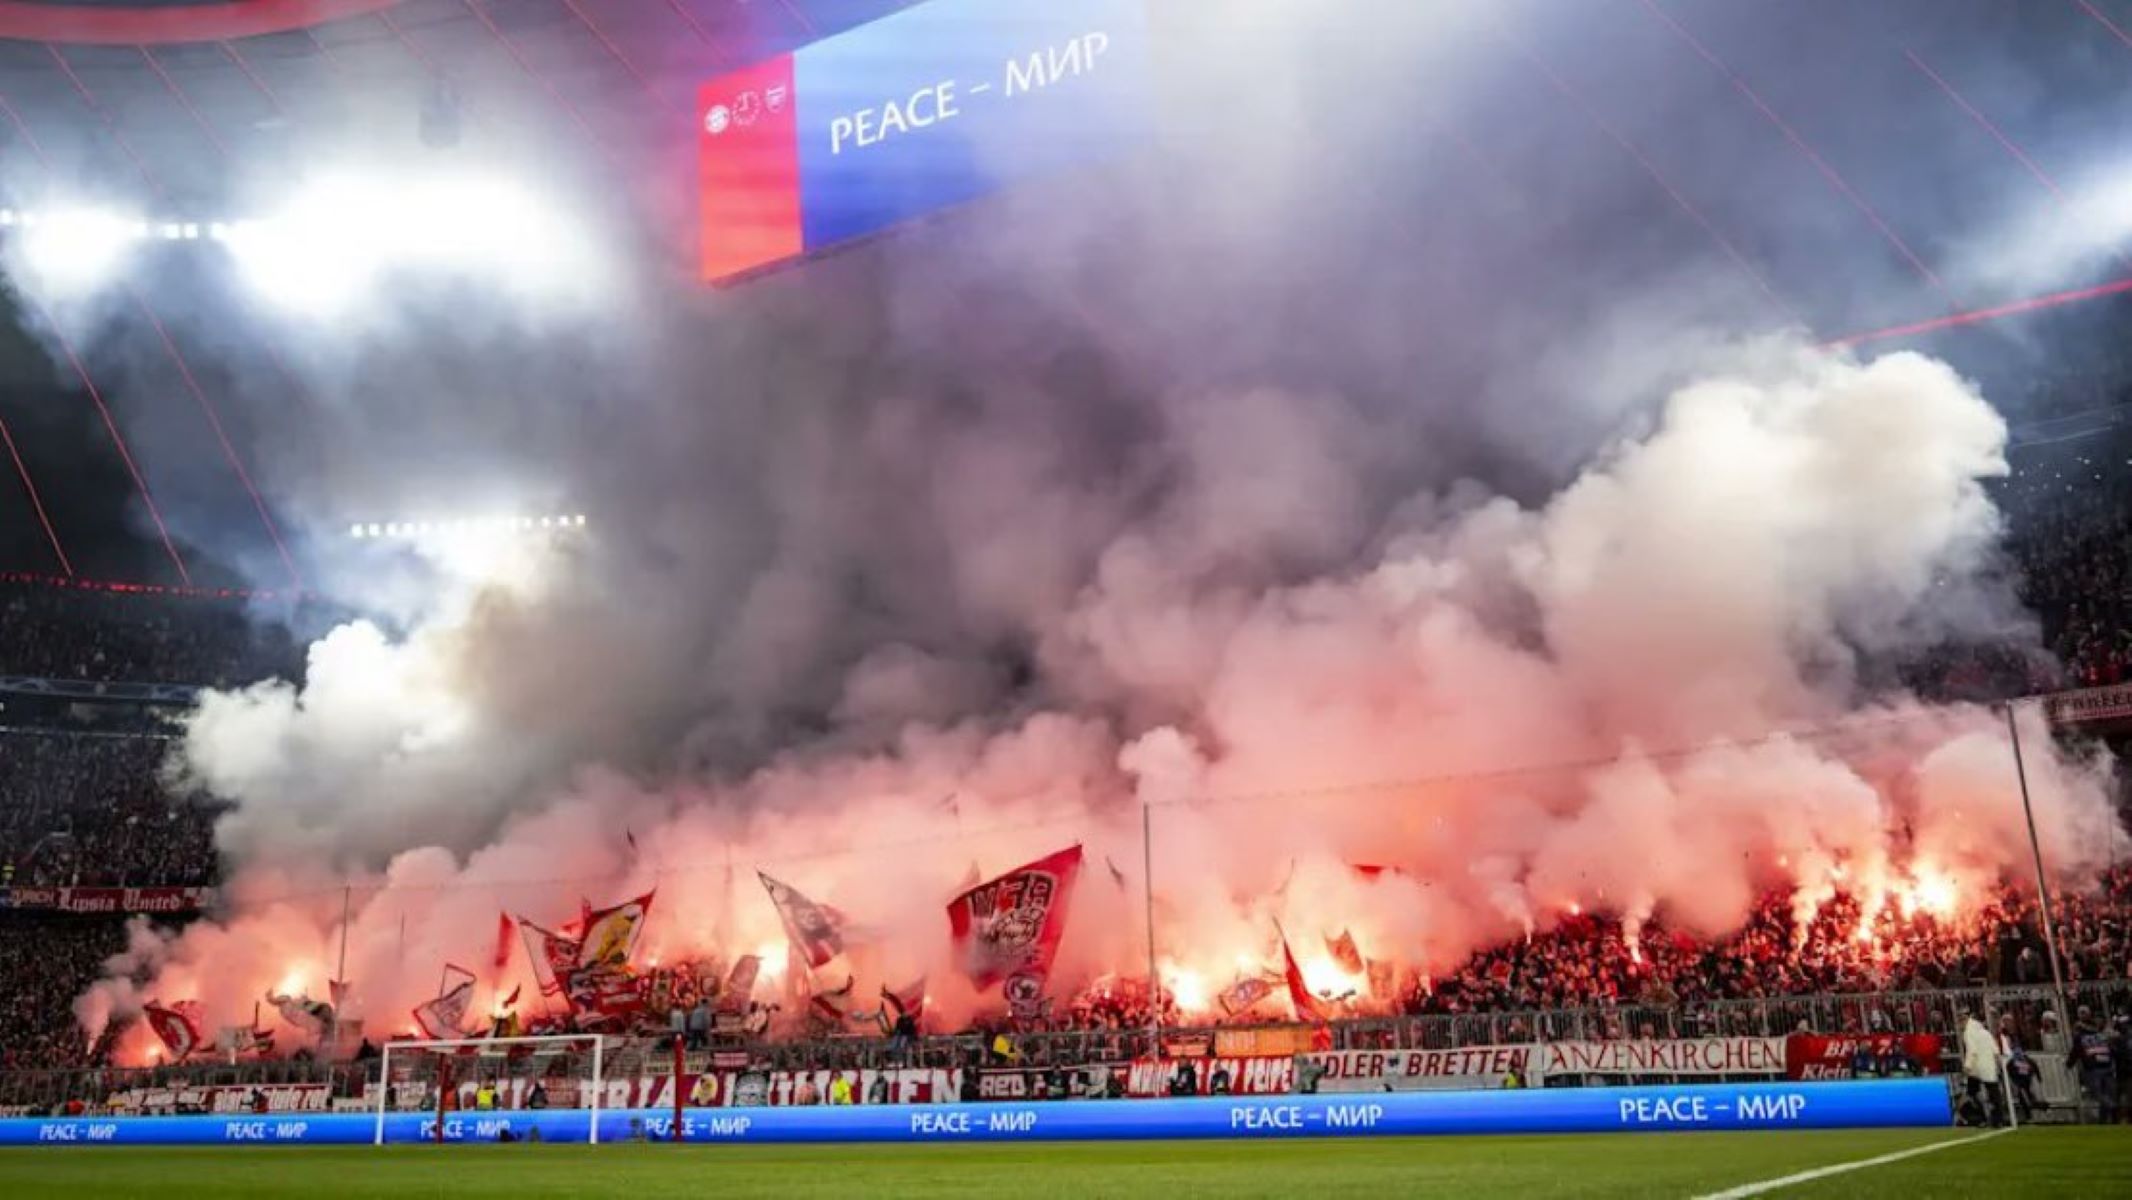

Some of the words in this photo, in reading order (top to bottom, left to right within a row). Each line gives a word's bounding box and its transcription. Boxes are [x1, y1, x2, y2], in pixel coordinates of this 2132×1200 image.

[831, 79, 960, 155] PEACE
[1005, 31, 1110, 98] МИР
[1550, 1039, 1783, 1072] ANZENKIRCHEN
[1231, 1106, 1303, 1129] PEACE
[1326, 1104, 1383, 1127] МИР
[1620, 1096, 1708, 1123] PEACE
[1737, 1094, 1806, 1120] МИР
[40, 1123, 77, 1141] PEACE
[226, 1122, 264, 1139] PEACE
[911, 1112, 970, 1133] PEACE
[990, 1111, 1037, 1132] МИР
